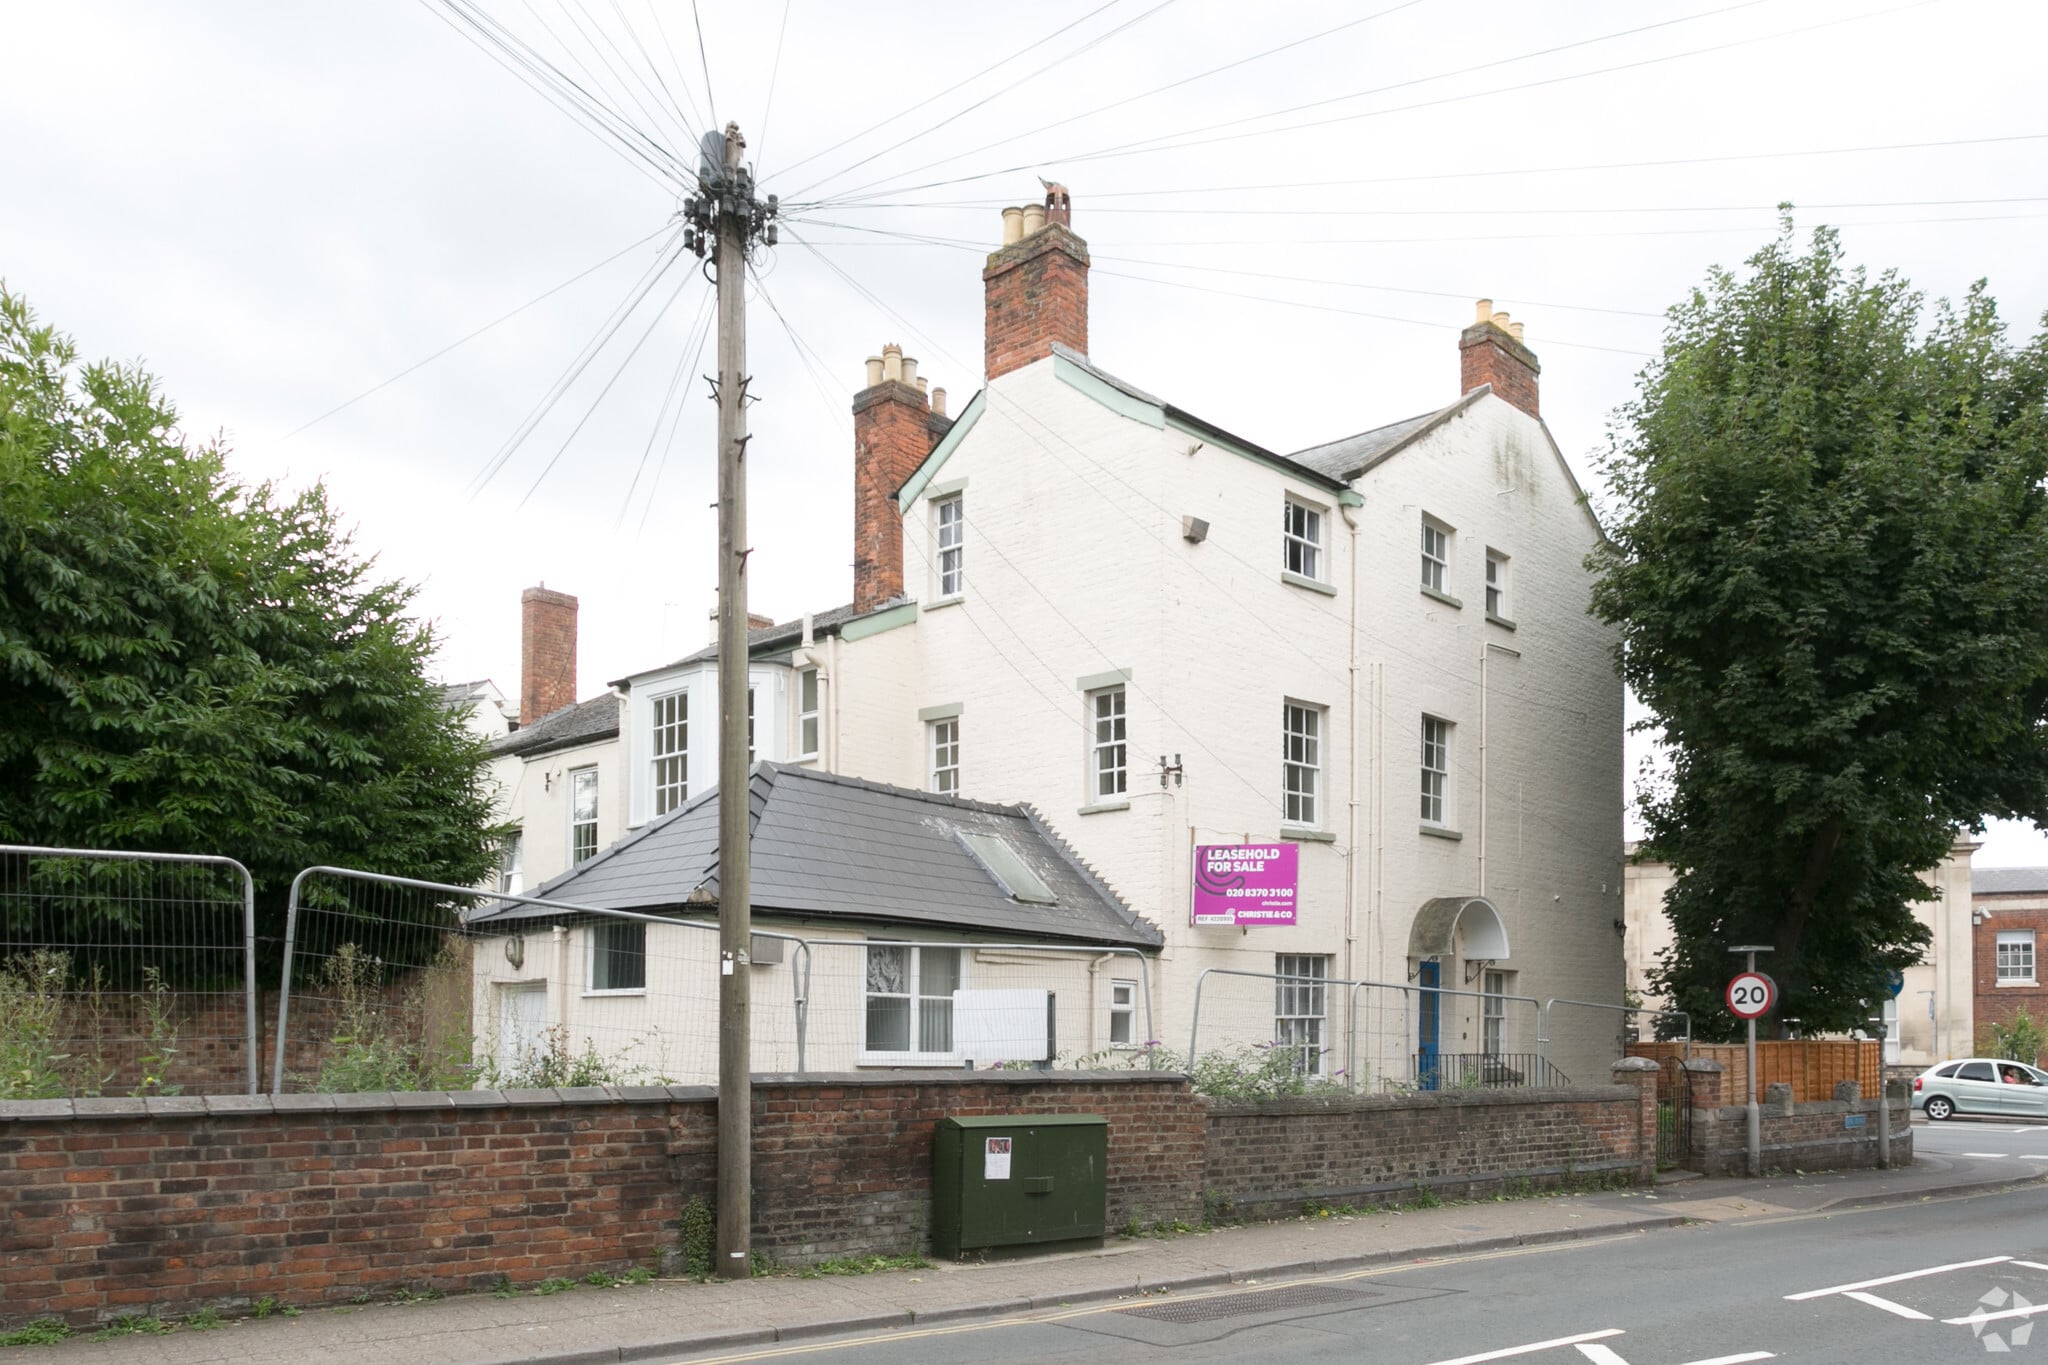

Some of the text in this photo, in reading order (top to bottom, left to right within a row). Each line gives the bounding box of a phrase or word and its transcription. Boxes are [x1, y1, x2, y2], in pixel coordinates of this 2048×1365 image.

[1207, 849, 1280, 860] LEASEHOLD
[1207, 861, 1265, 872] FOR SALE
[1226, 888, 1293, 897] 020 8370 3100
[1280, 910, 1293, 918] CO
[1734, 986, 1765, 1005] 20
